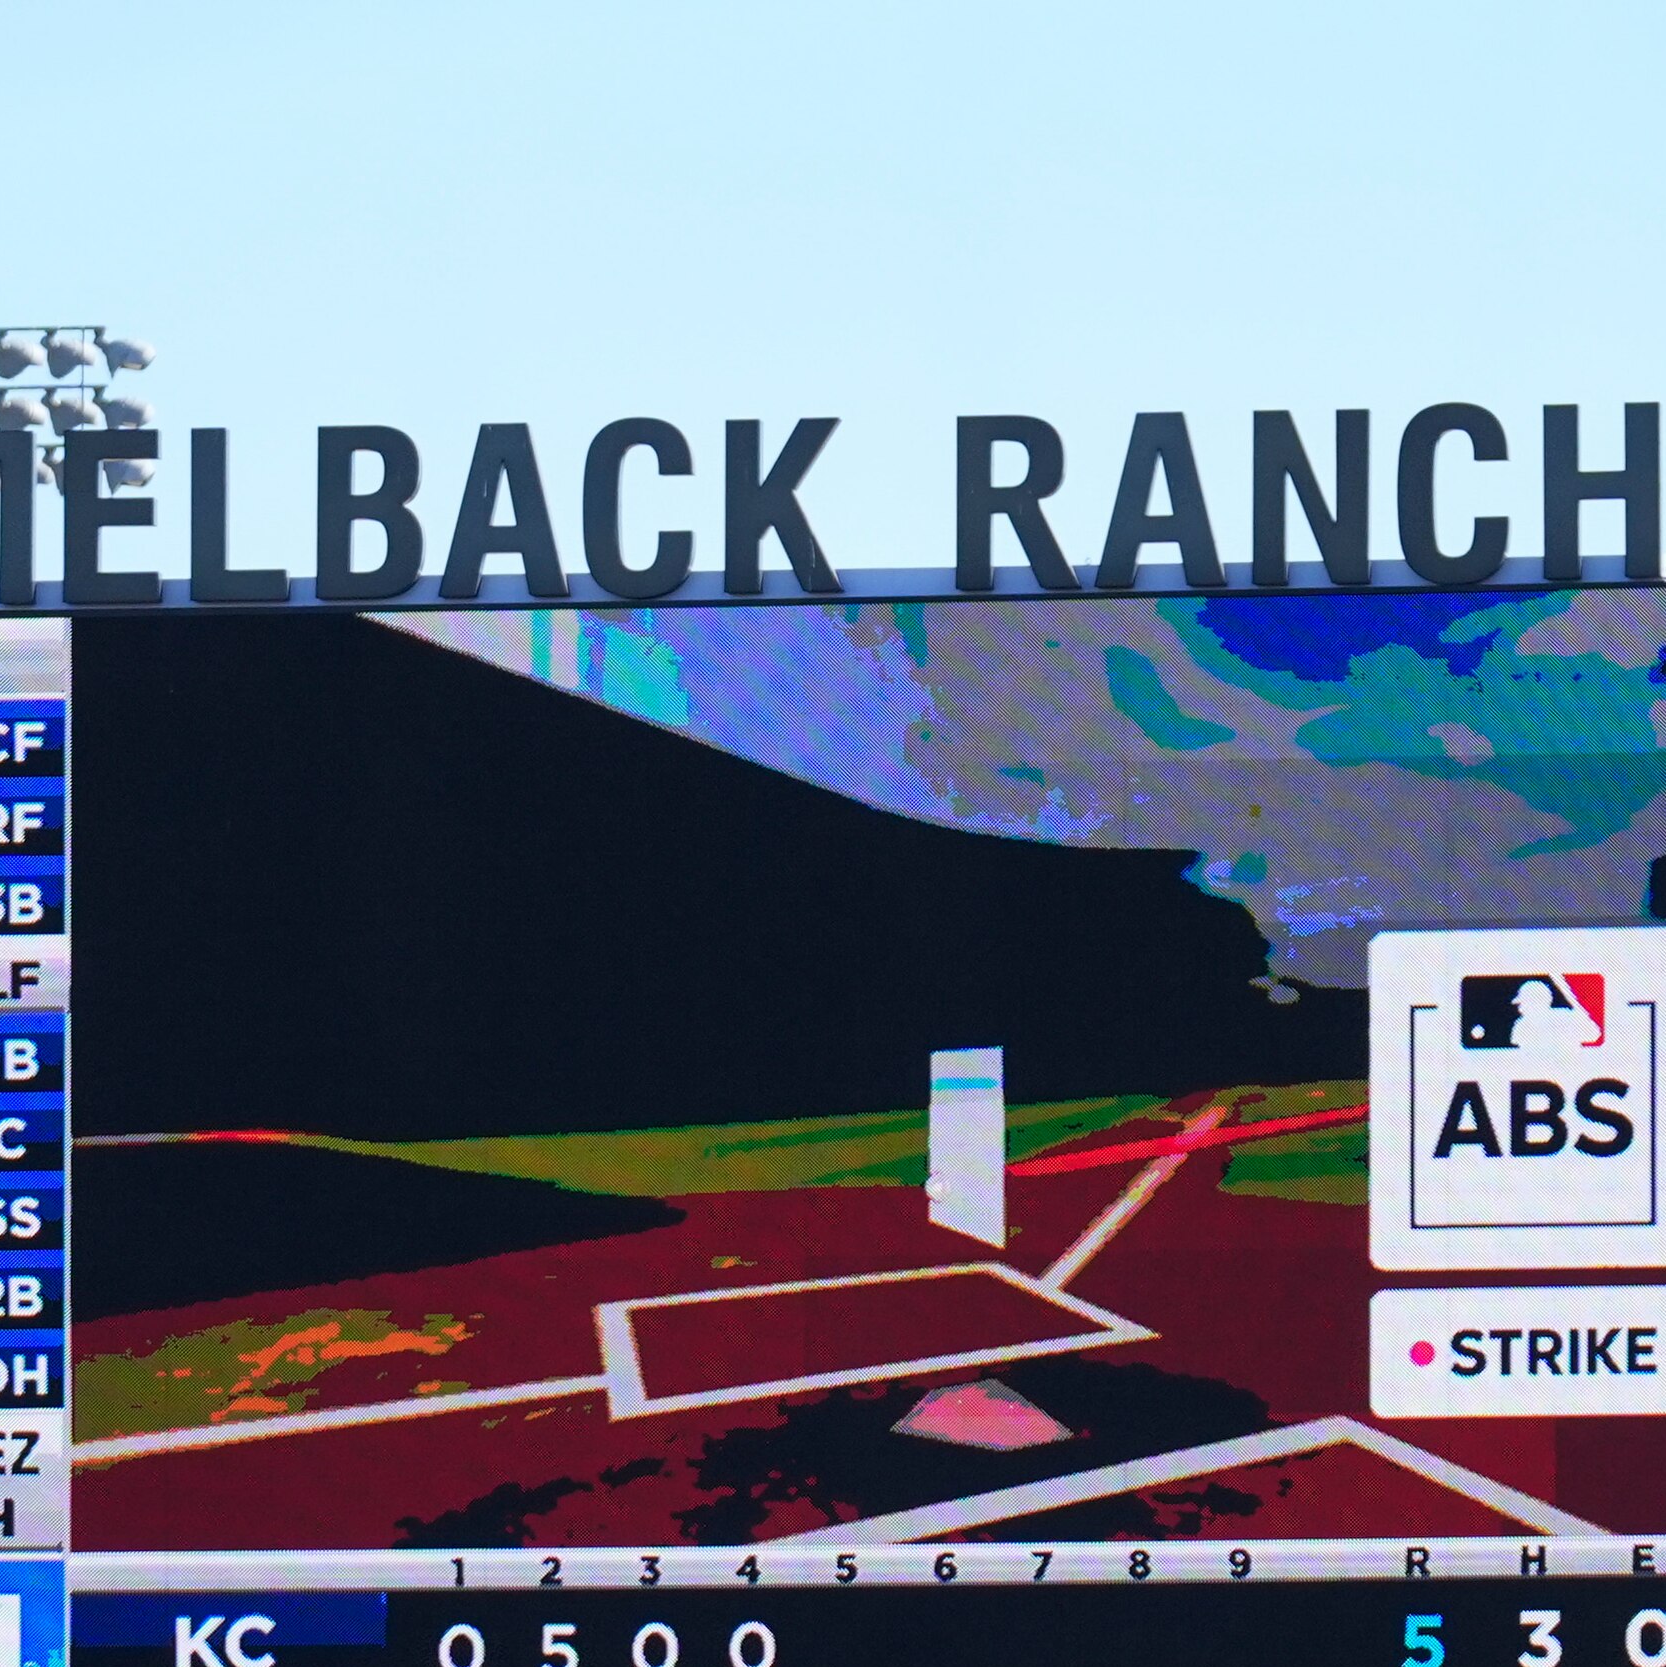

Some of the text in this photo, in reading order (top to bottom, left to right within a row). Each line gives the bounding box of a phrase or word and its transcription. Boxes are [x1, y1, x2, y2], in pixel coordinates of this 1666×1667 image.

[953, 401, 1660, 592] RANCH
[1432, 1077, 1635, 1159] ABS
[1449, 1326, 1659, 1377] STRIKE
[451, 1544, 1656, 1587] 1 2 3 4 5 6 7 8 9 R H E
